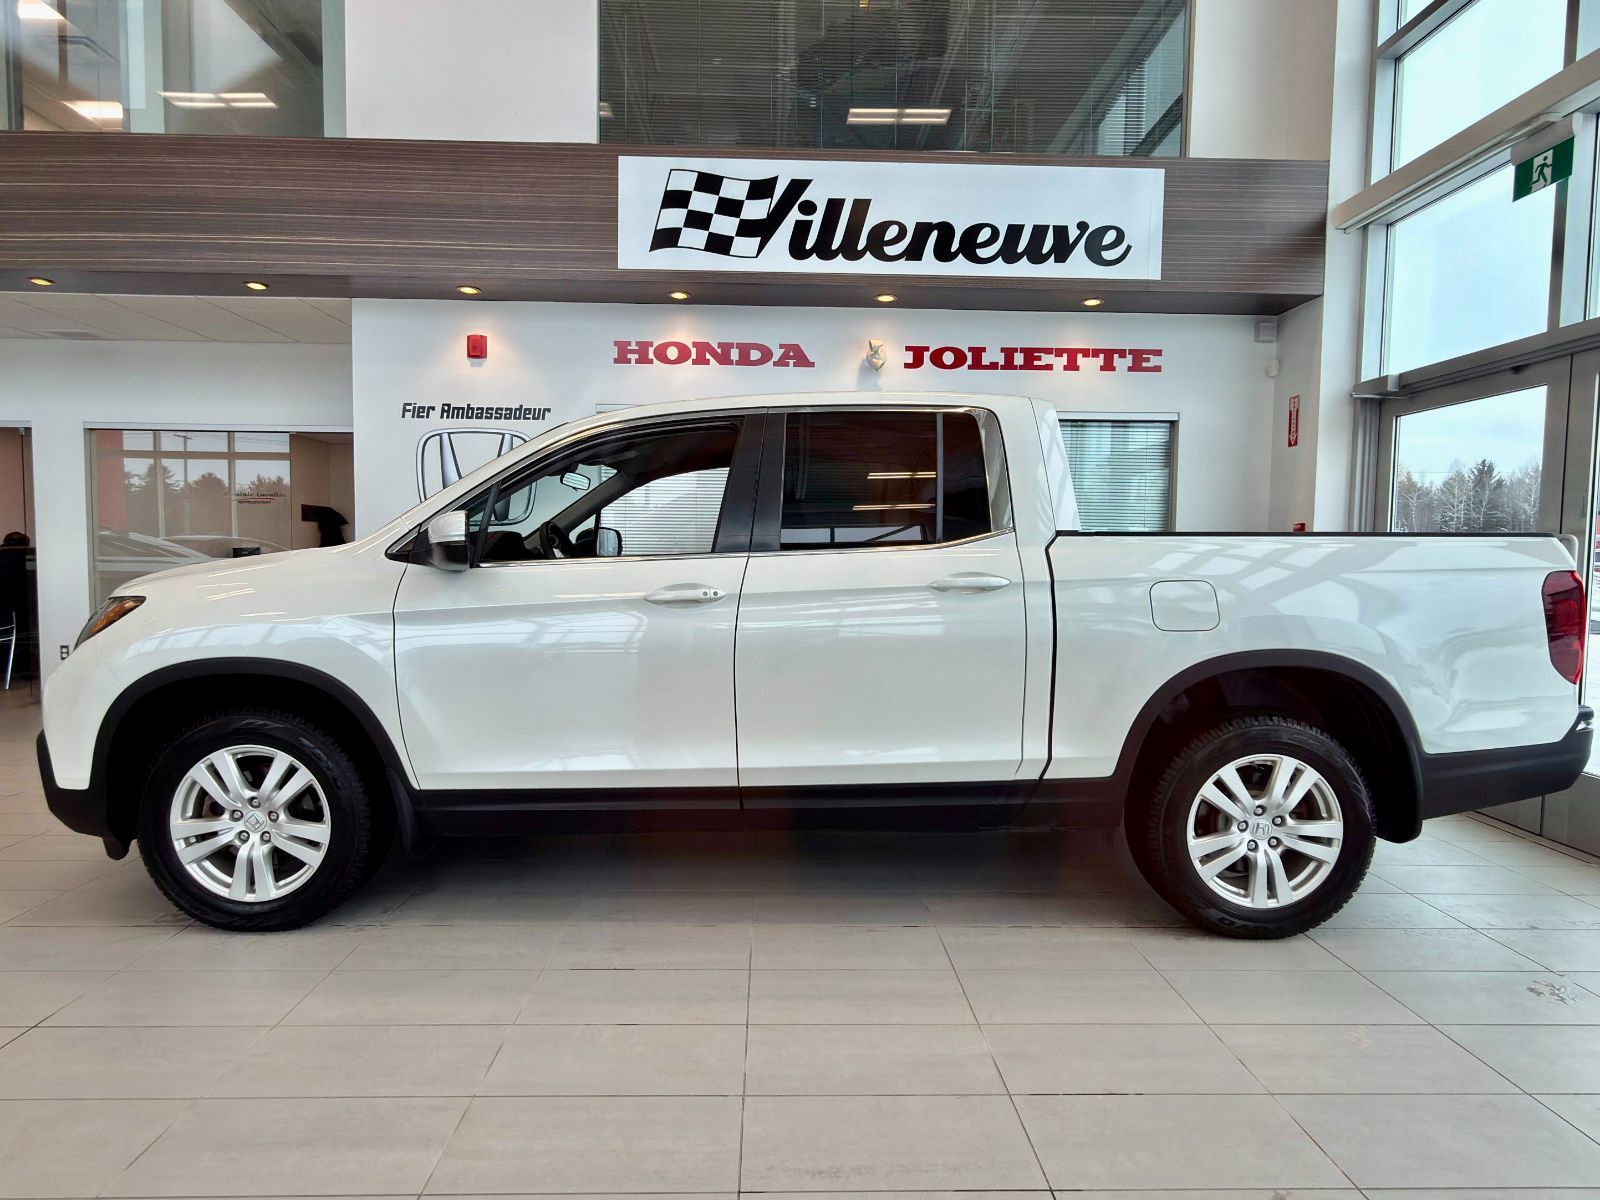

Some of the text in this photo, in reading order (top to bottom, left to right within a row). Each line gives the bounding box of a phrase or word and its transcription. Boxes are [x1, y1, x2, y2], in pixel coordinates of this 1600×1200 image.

[752, 176, 1133, 268] Villeneuve
[613, 340, 1163, 373] HONDA JOLIETTE
[401, 402, 552, 421] Fier Ambassadeur
